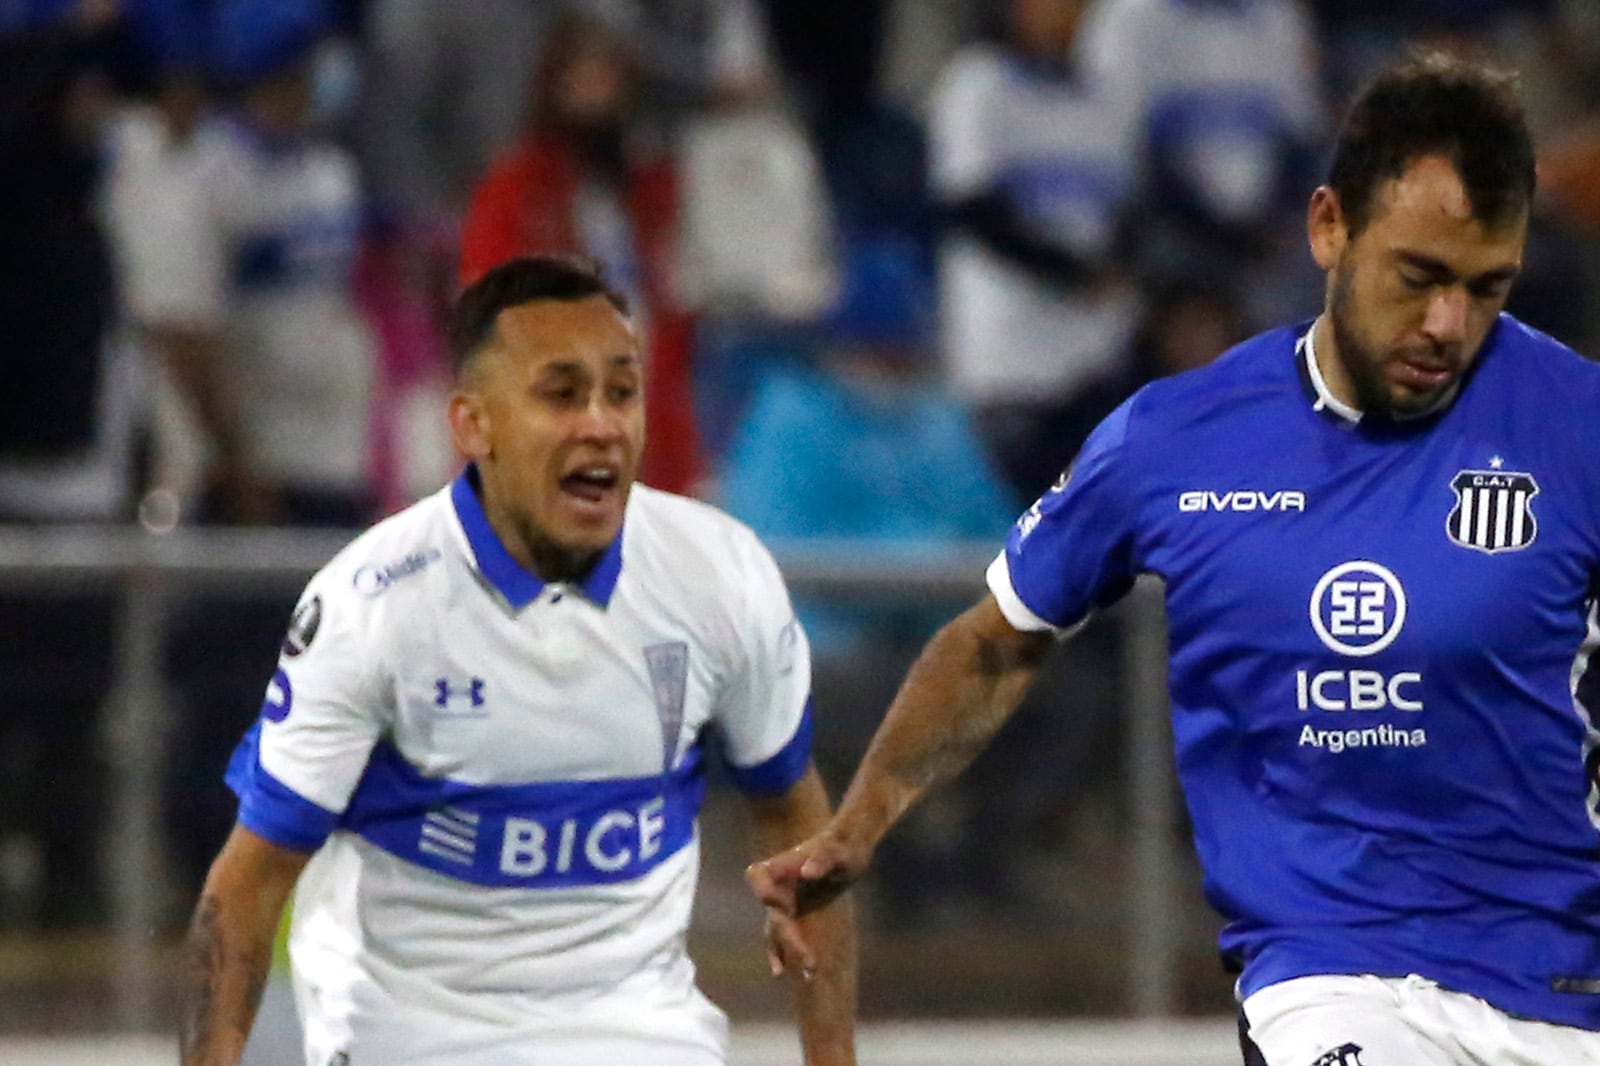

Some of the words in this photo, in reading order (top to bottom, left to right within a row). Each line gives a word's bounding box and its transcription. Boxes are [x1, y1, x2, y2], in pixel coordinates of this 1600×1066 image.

[1178, 490, 1305, 512] GIVOVA
[1296, 669, 1424, 712] ICBC
[1299, 723, 1426, 754] Argentina
[500, 796, 665, 878] BICE
